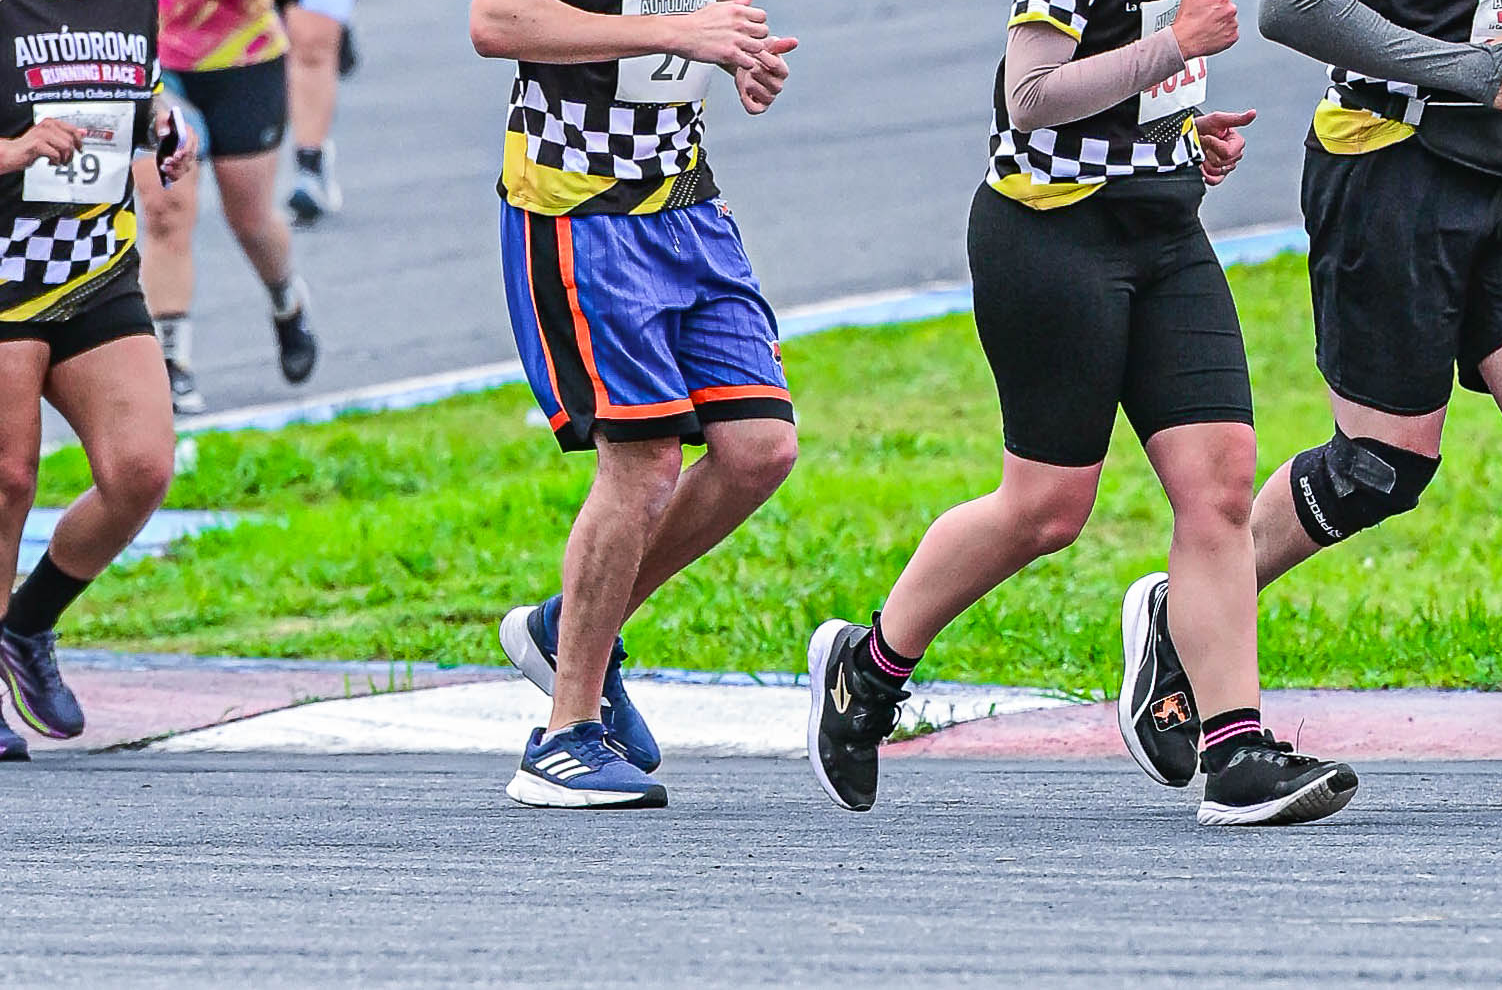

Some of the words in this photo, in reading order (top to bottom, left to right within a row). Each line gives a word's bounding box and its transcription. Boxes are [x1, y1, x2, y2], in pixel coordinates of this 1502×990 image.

[1125, 2, 1137, 12] La
[15, 24, 148, 68] AUTÓDROMO
[41, 63, 100, 85] RUNNING
[101, 64, 137, 84] RACE
[15, 92, 28, 103] La
[55, 152, 100, 185] 49
[1299, 475, 1334, 531] PROCER
